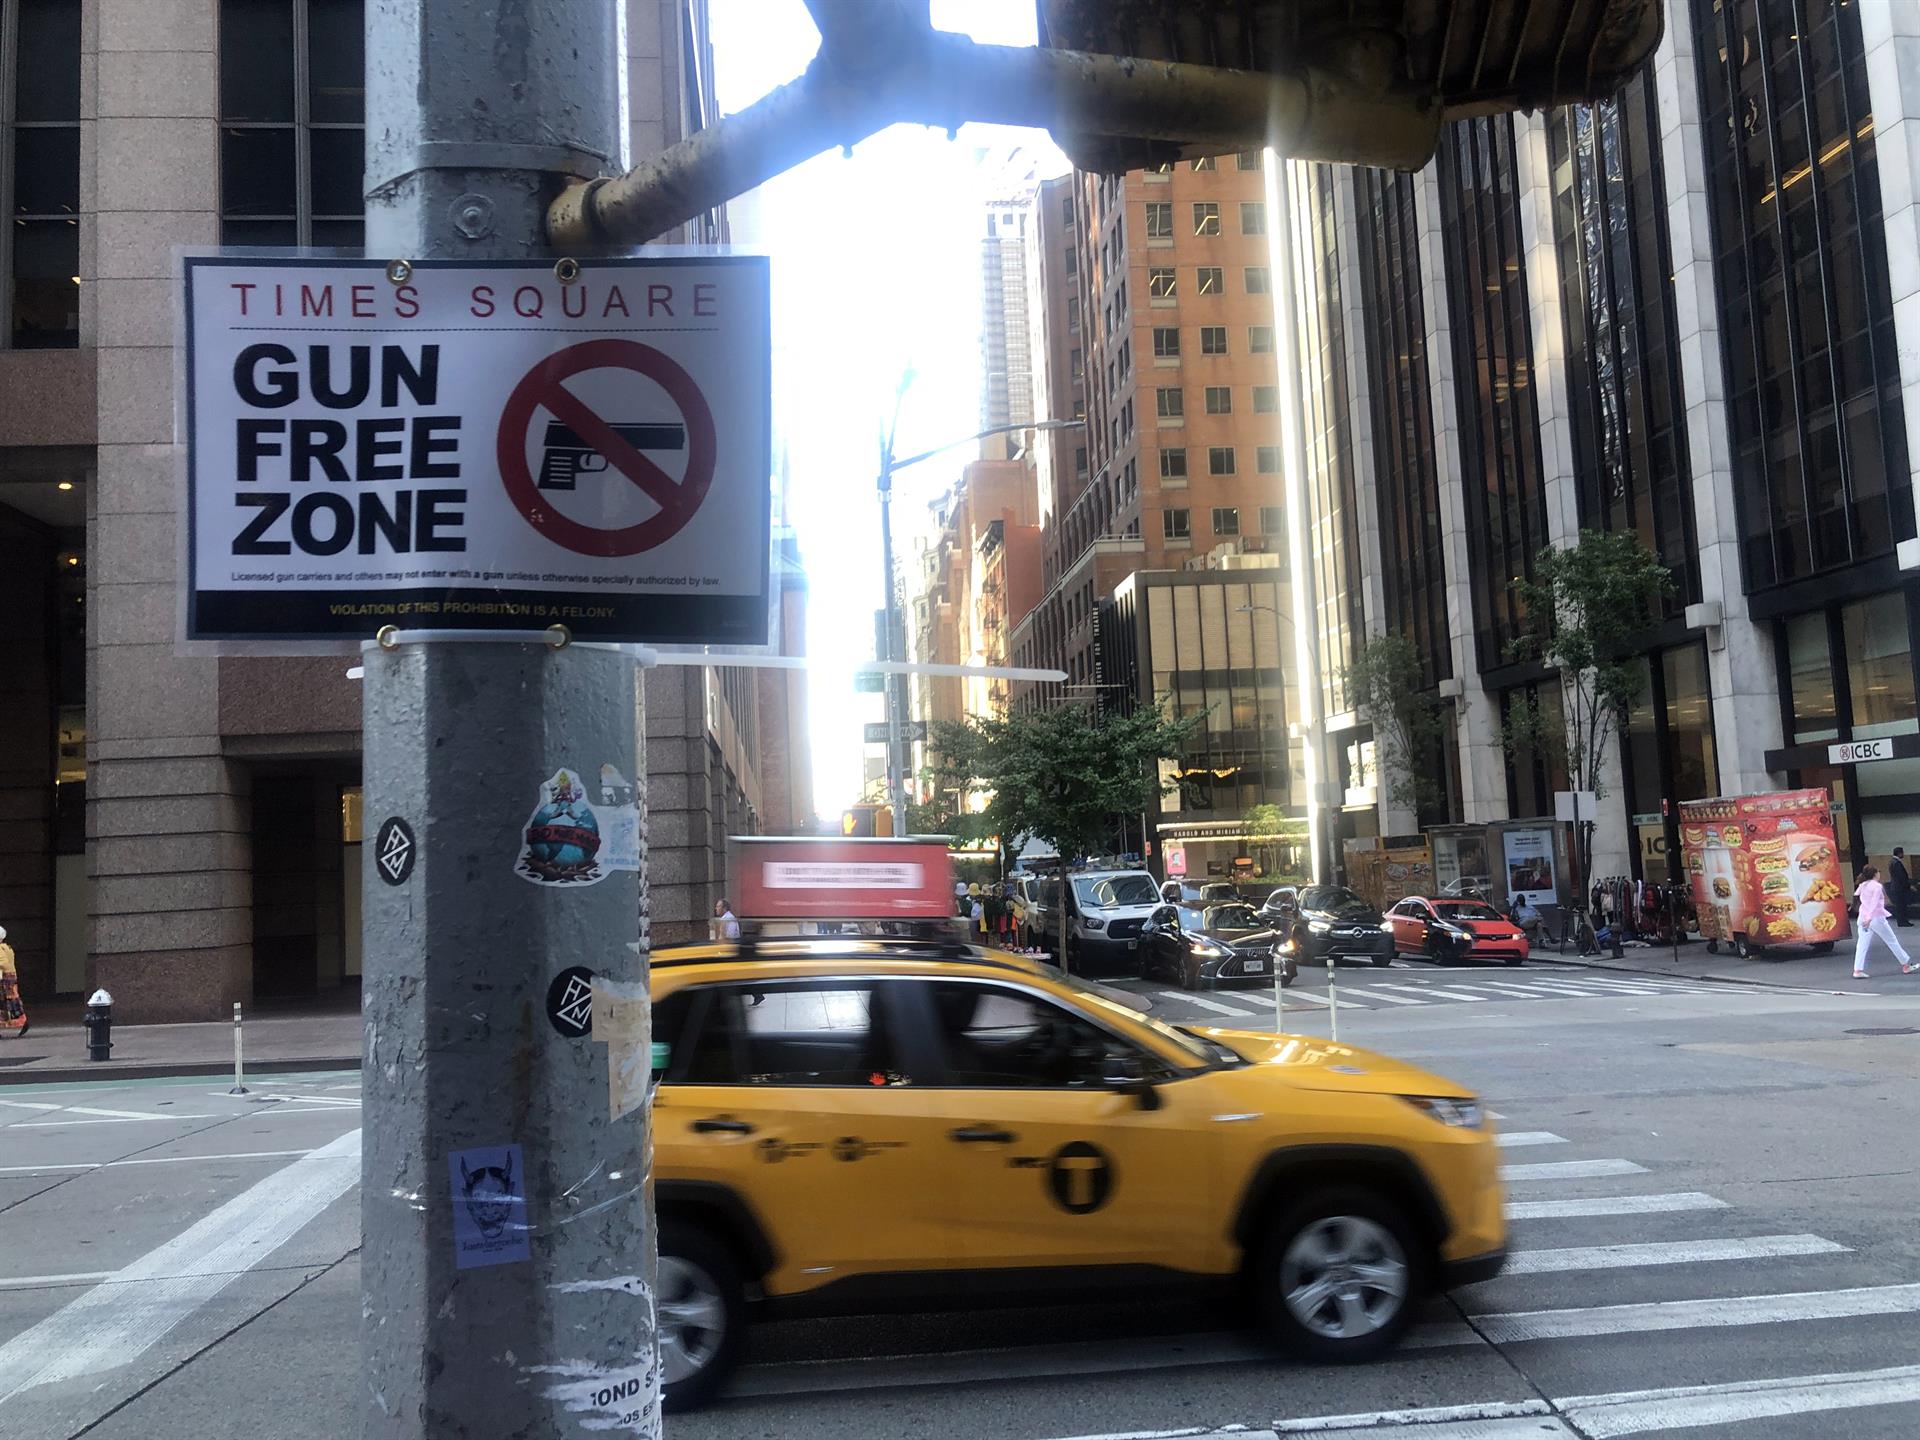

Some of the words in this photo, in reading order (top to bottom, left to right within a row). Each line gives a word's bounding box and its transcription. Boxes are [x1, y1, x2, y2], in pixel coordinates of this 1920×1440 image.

[231, 284, 420, 318] TIMES
[470, 284, 718, 319] SQUARE
[232, 343, 439, 409] GUN
[236, 416, 462, 483] FREE
[232, 489, 467, 556] ZONE
[231, 572, 274, 581] Licensed
[277, 574, 294, 583] gun
[297, 572, 332, 581] carriers
[334, 572, 352, 581] and
[355, 572, 383, 581] others
[385, 572, 403, 581] may
[405, 571, 419, 579] not
[421, 570, 447, 578] enter
[449, 570, 472, 578] with
[483, 572, 504, 581] gun
[506, 571, 540, 581] unless
[542, 572, 589, 584] otherwise
[592, 574, 634, 586] specially
[636, 575, 686, 585] authorized
[689, 576, 700, 587] by
[702, 576, 721, 586] law.
[329, 603, 395, 615] VIOLATION
[397, 603, 411, 614] OF
[413, 602, 439, 613] THIS
[443, 602, 530, 615] PROHIBITION
[534, 605, 546, 616] IS
[548, 606, 560, 616] A
[562, 606, 616, 618] FELONY.
[1092, 606, 1101, 636] THEATRE
[1850, 742, 1881, 760] ICBC
[1173, 830, 1199, 838] HAROLD
[1200, 829, 1214, 837] AND
[617, 1410, 640, 1425] OS
